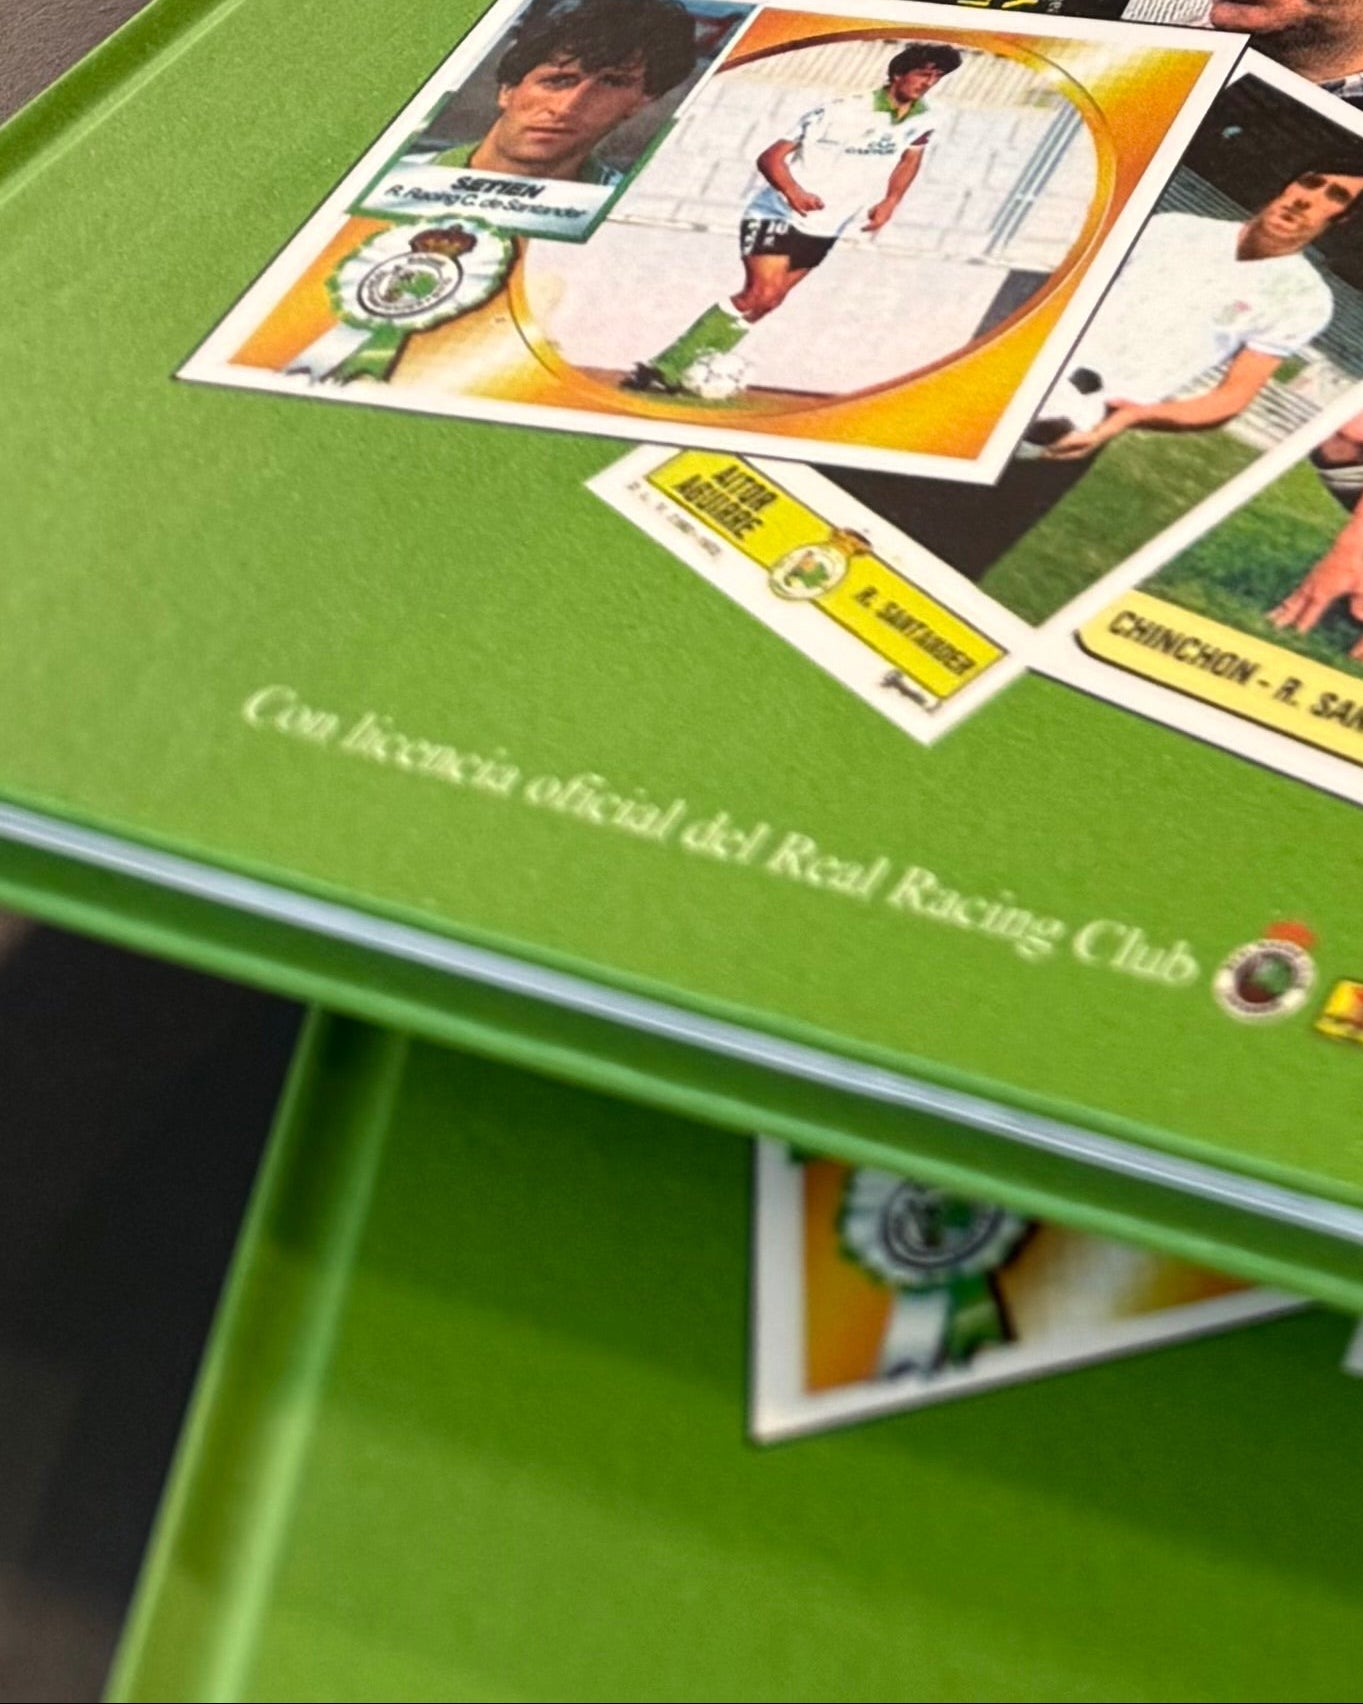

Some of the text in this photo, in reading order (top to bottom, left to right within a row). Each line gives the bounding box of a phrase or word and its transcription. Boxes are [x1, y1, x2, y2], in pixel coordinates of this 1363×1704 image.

[451, 176, 546, 198] SETIEN
[674, 473, 766, 541] AGUIRRE
[712, 463, 779, 512] AITOR
[854, 584, 978, 676] R. SANTANDER
[1108, 610, 1262, 688] CHINCHON
[1273, 678, 1303, 706] R.
[242, 684, 1199, 985] Con licencia oficial del Real Racing Club
